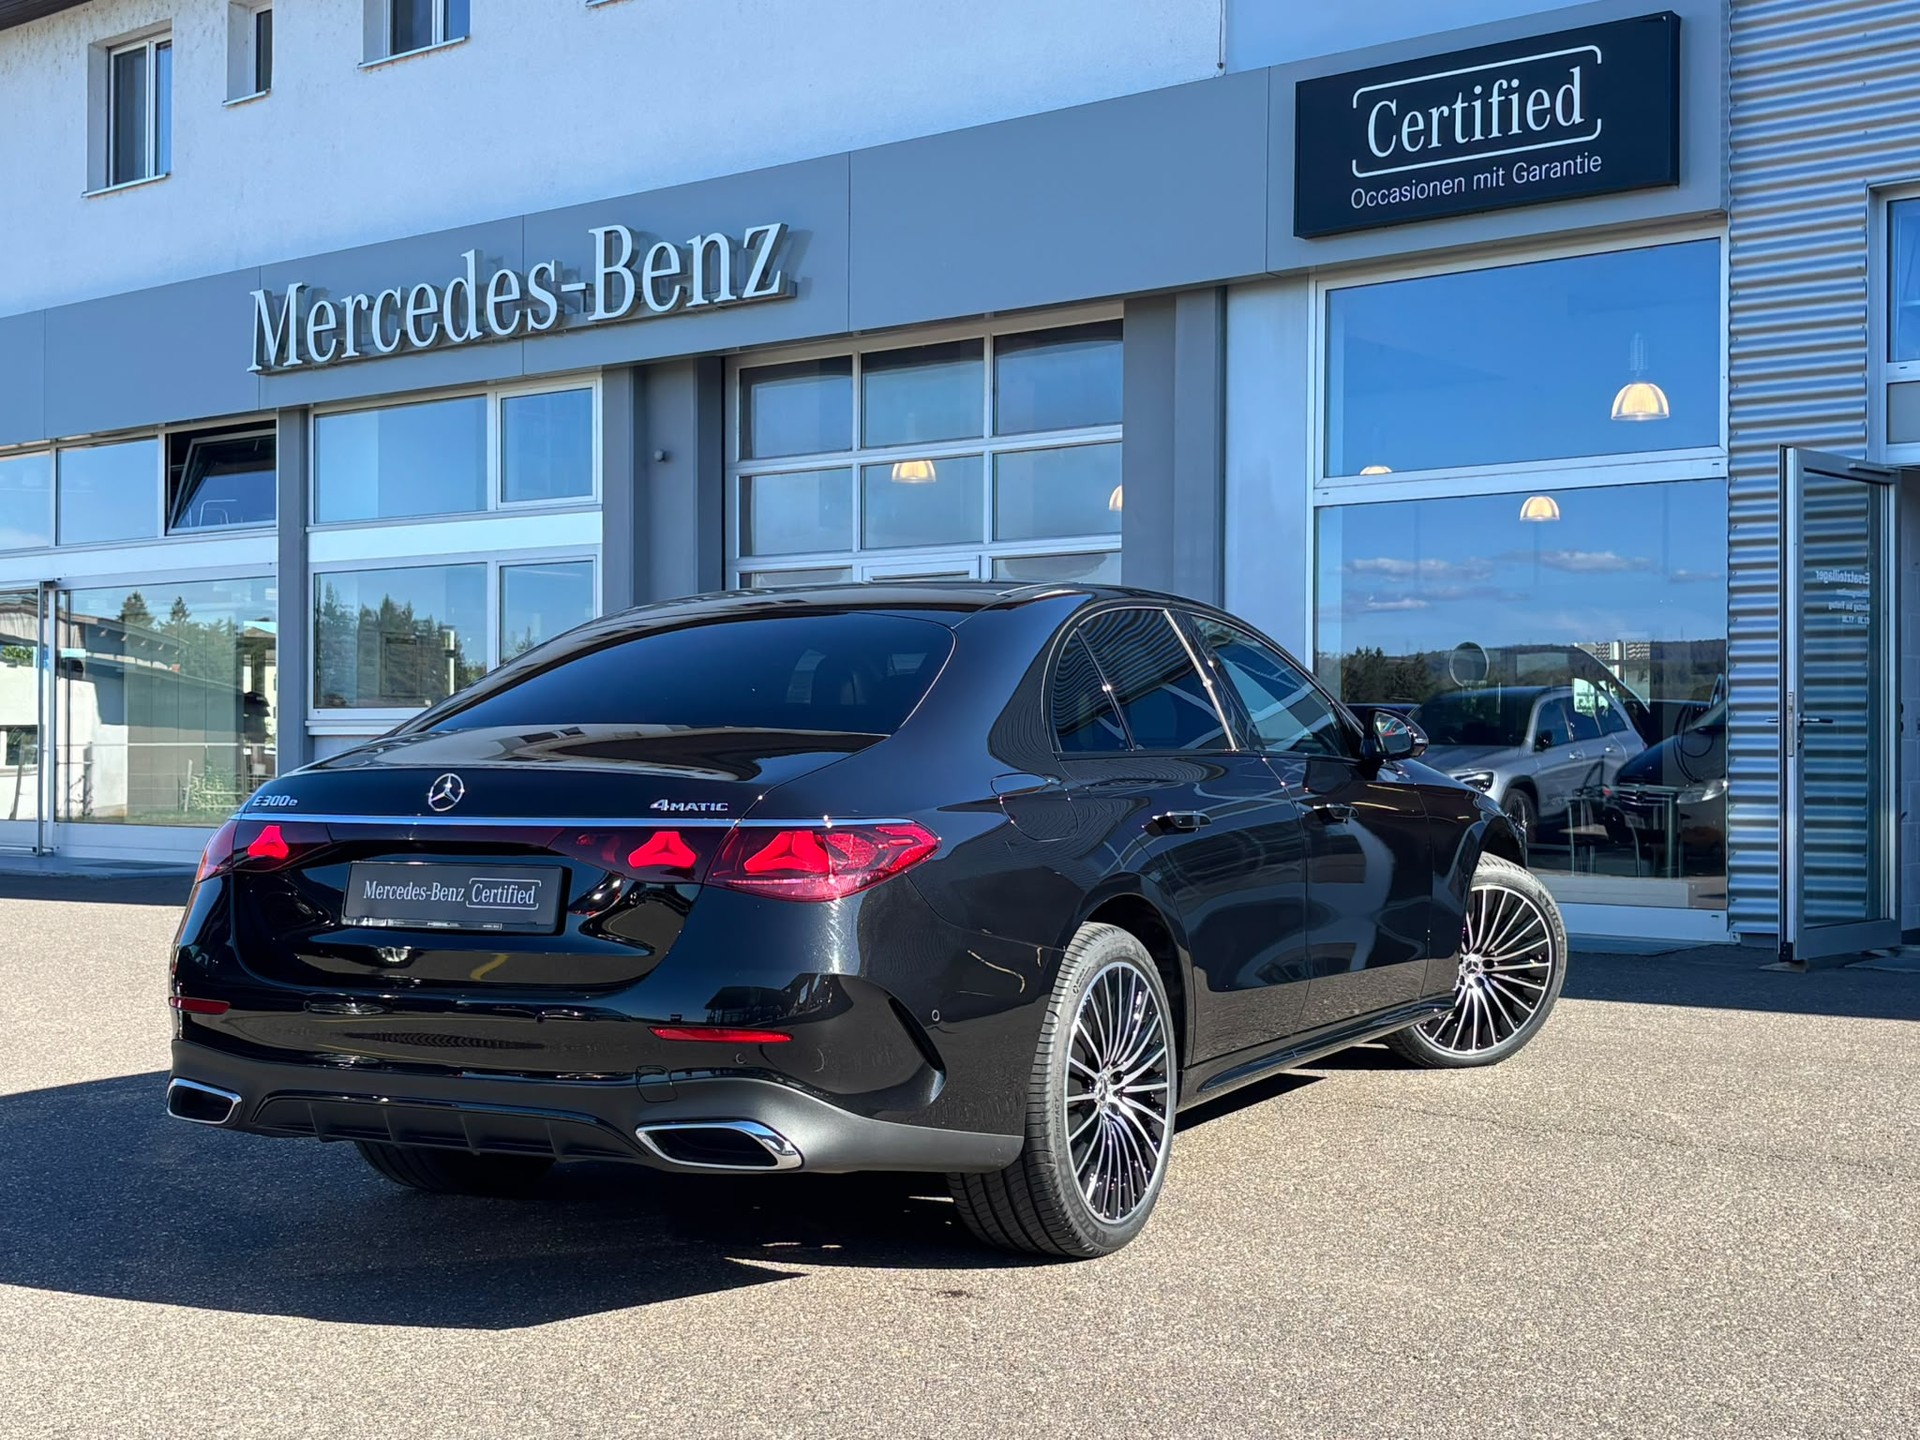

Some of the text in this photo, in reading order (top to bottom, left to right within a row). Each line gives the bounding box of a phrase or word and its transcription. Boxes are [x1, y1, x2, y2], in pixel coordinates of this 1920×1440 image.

[1366, 66, 1585, 158] Certified
[1350, 151, 1603, 210] Occasionen mit Garantie
[246, 222, 788, 373] Mercedes-Benz
[649, 799, 729, 812] 4MATIC
[363, 880, 536, 905] Mercedes-Benz Certified
